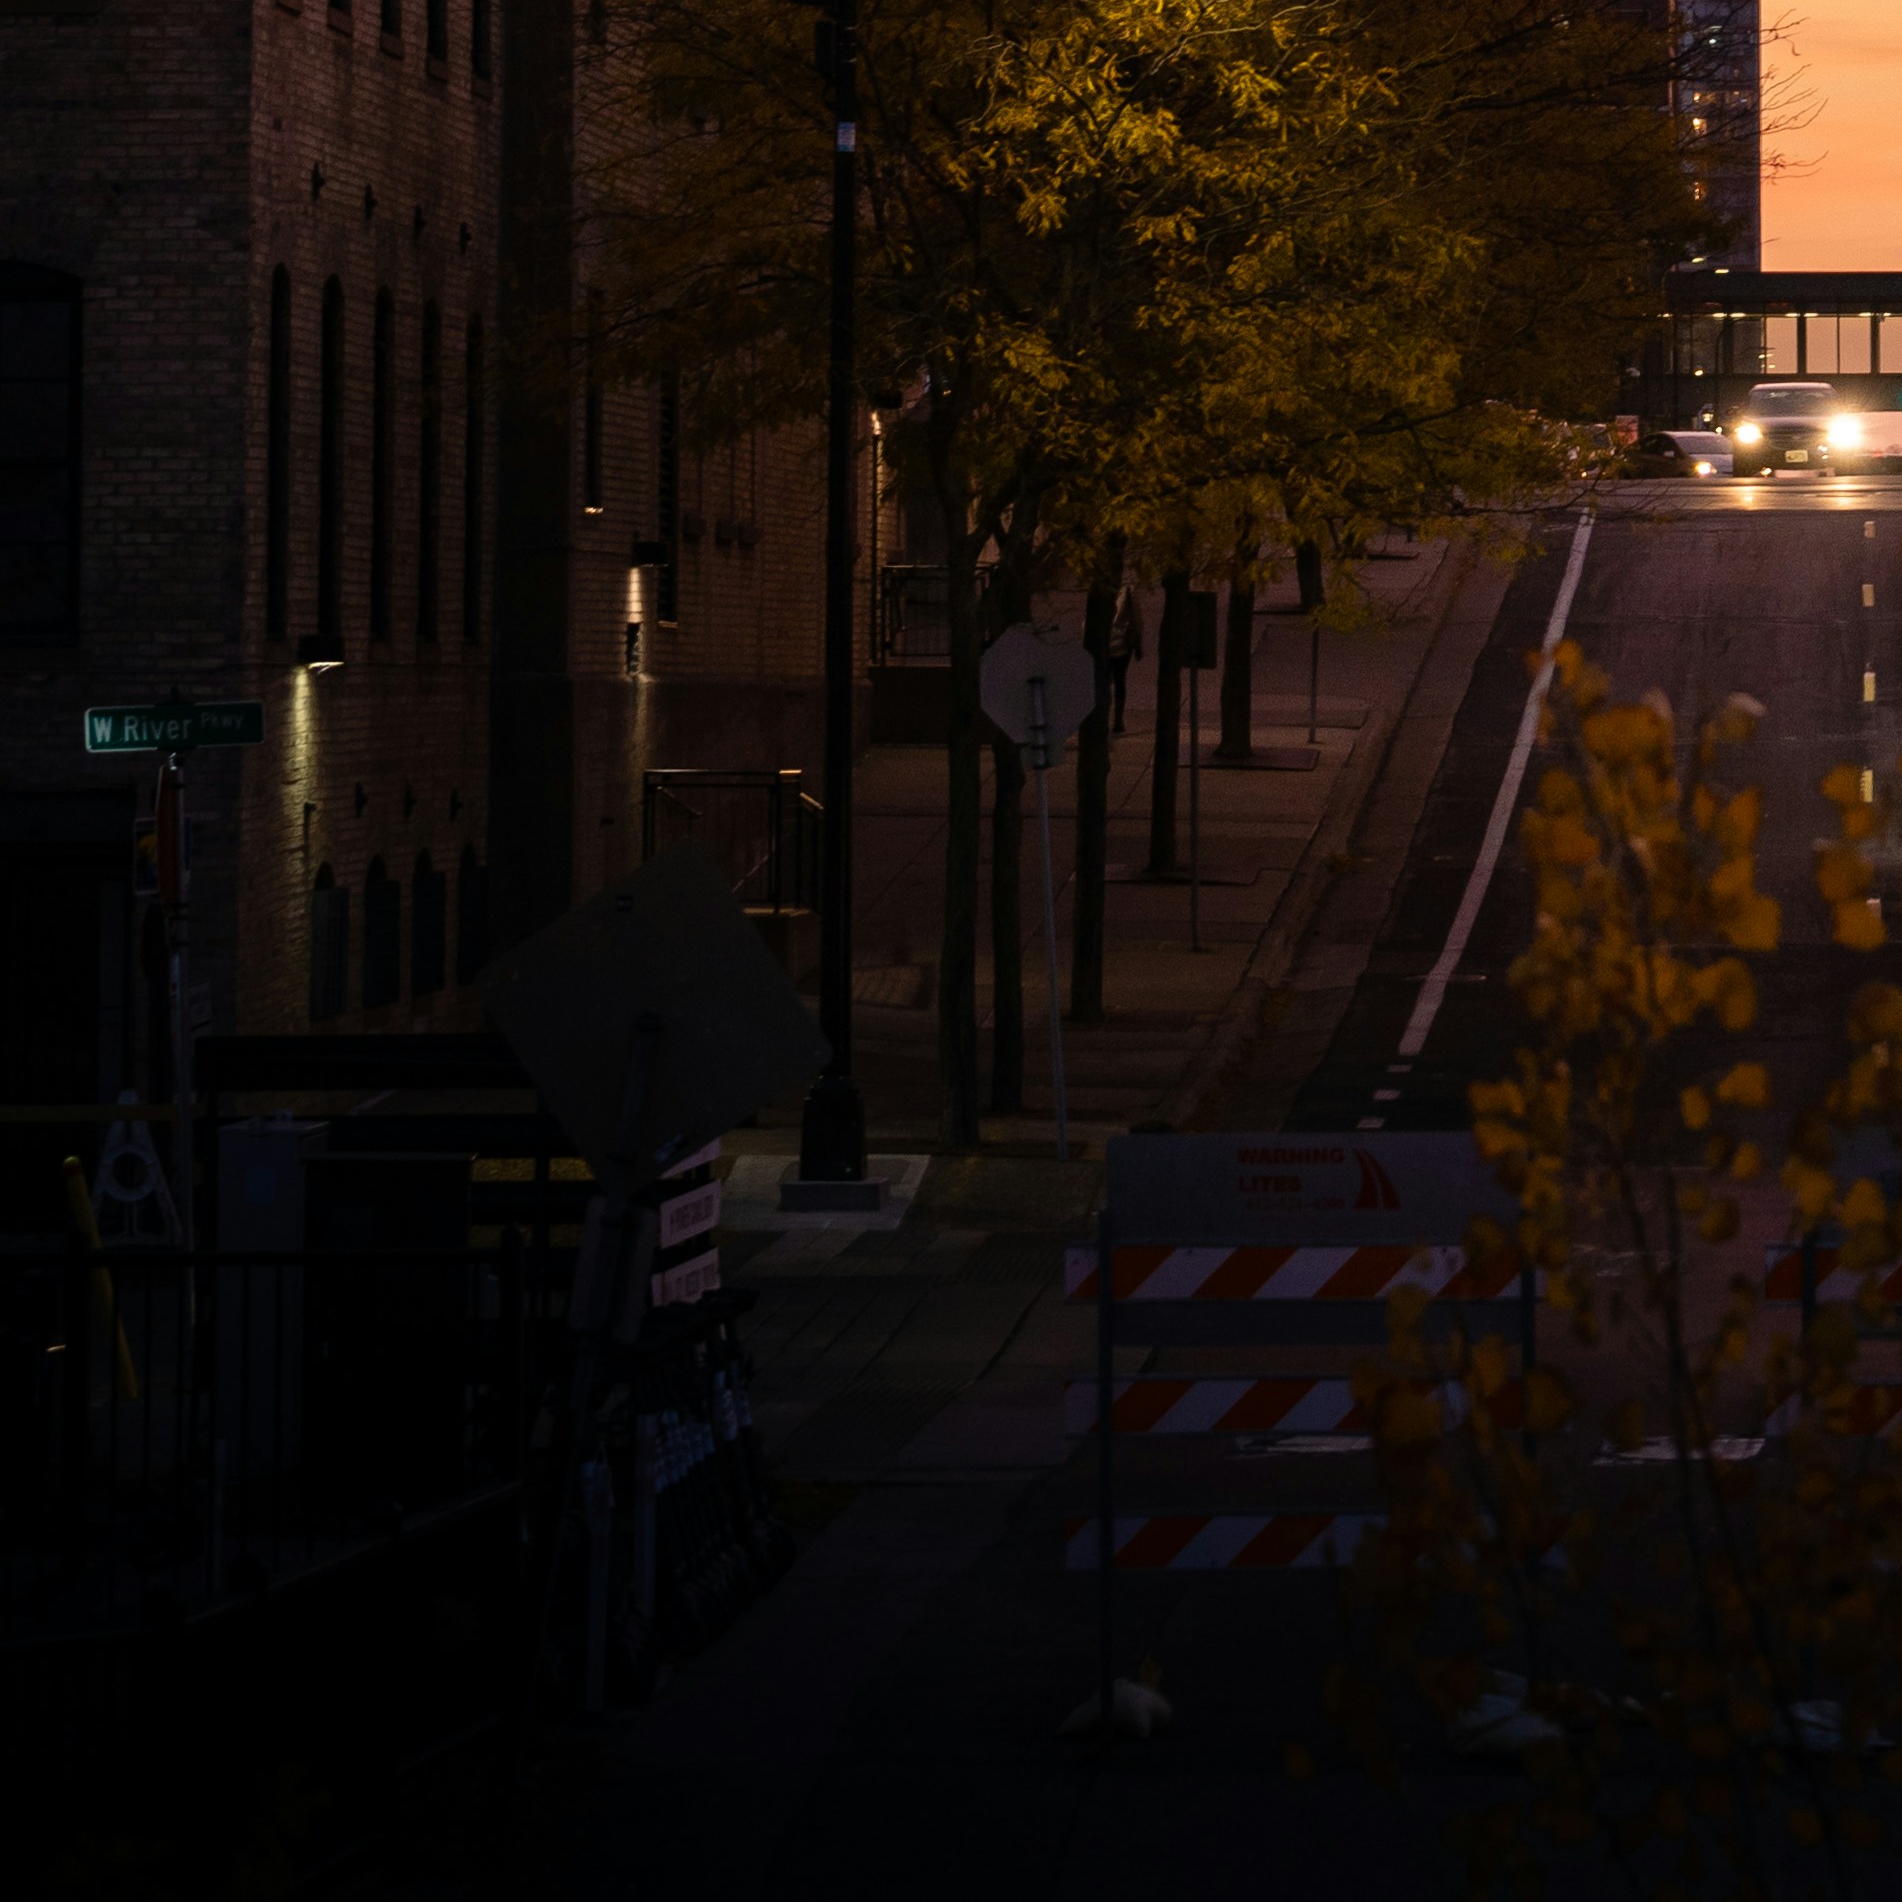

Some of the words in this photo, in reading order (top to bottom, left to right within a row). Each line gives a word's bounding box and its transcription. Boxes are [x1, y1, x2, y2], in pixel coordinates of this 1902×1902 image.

[93, 715, 113, 743] W
[124, 714, 193, 742] River
[201, 711, 245, 730] Pkwy
[1237, 1148, 1345, 1164] WARNING
[1239, 1175, 1301, 1192] LITES
